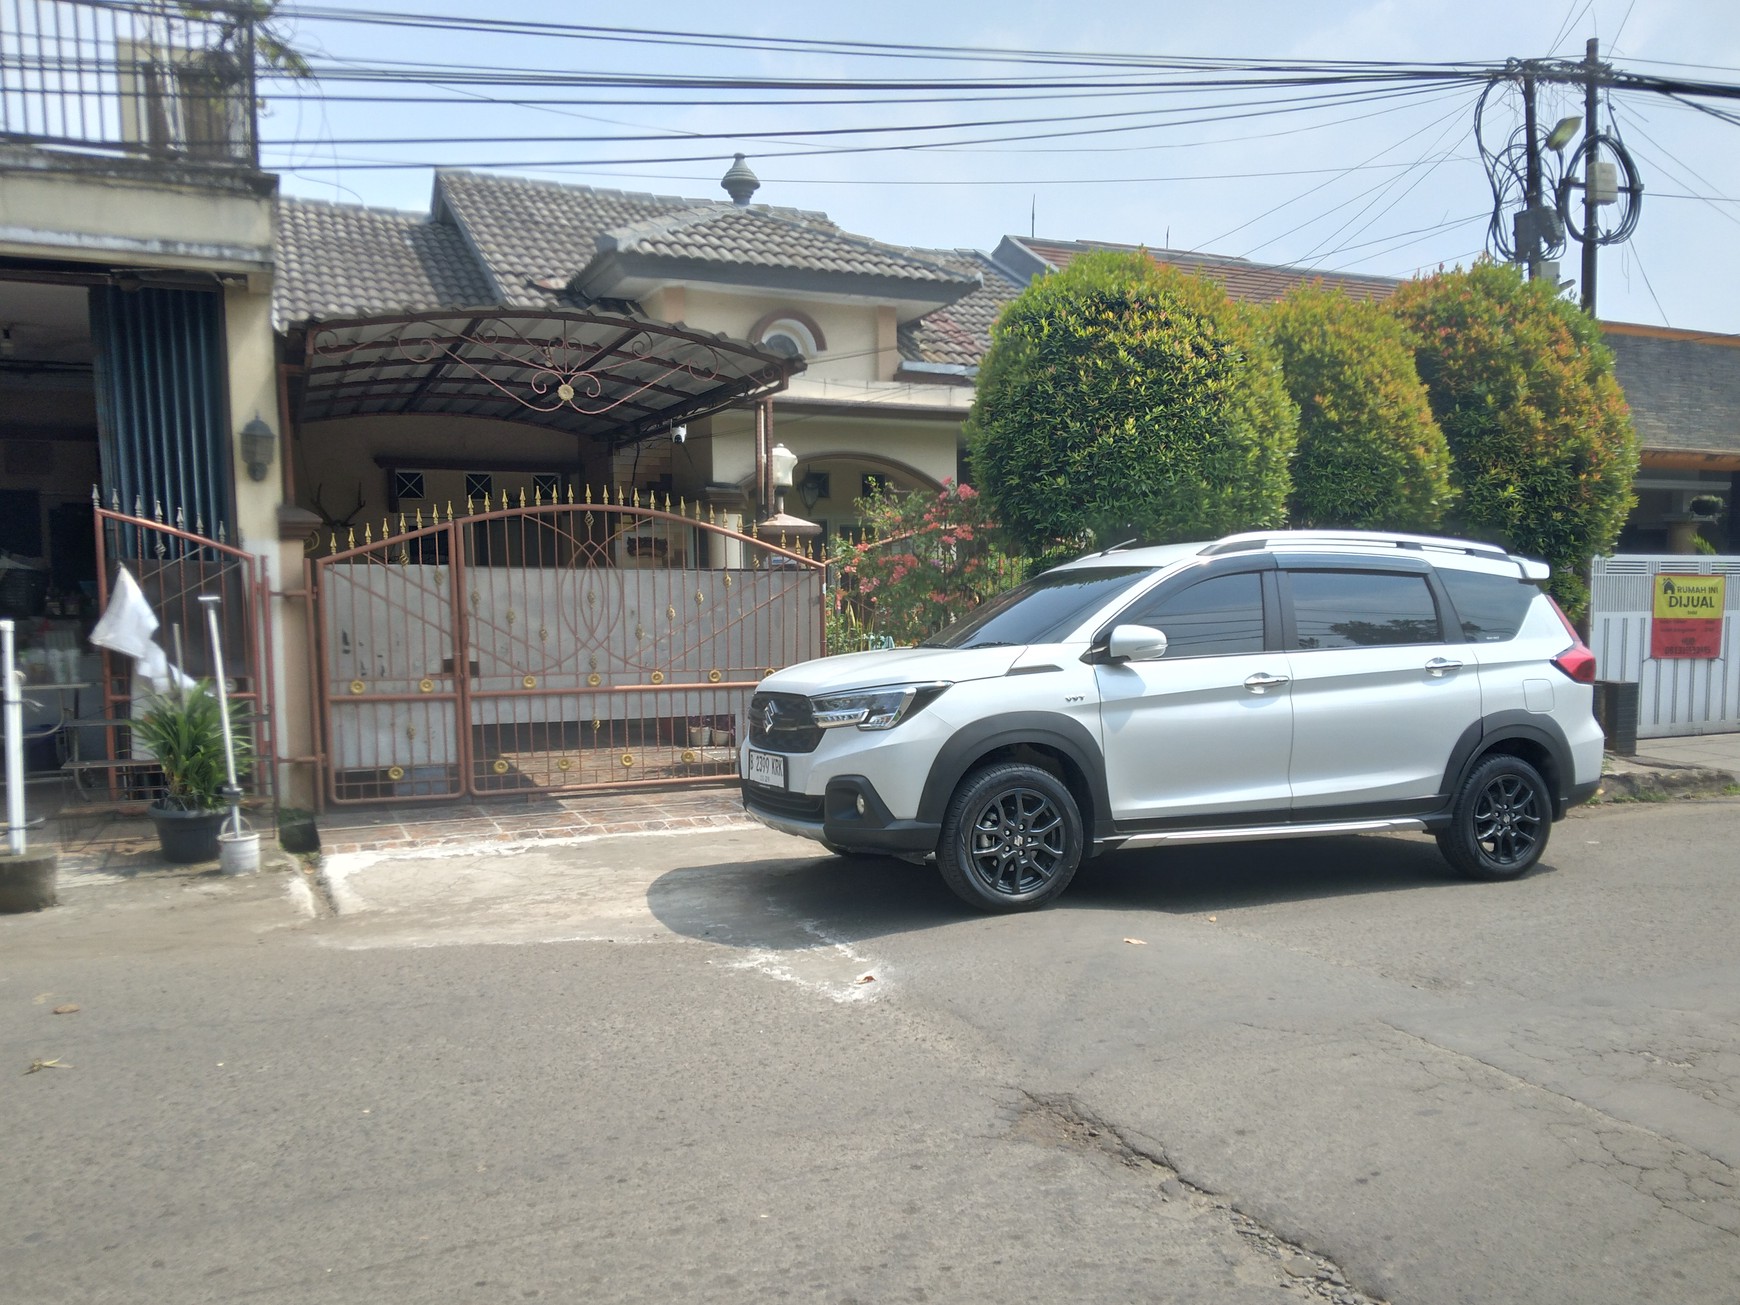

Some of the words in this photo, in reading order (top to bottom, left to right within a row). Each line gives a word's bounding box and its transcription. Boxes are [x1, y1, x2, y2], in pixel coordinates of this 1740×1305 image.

[1677, 586, 1706, 594] RUMAH
[1708, 586, 1718, 594] INI
[1669, 595, 1715, 608] DIJUAL
